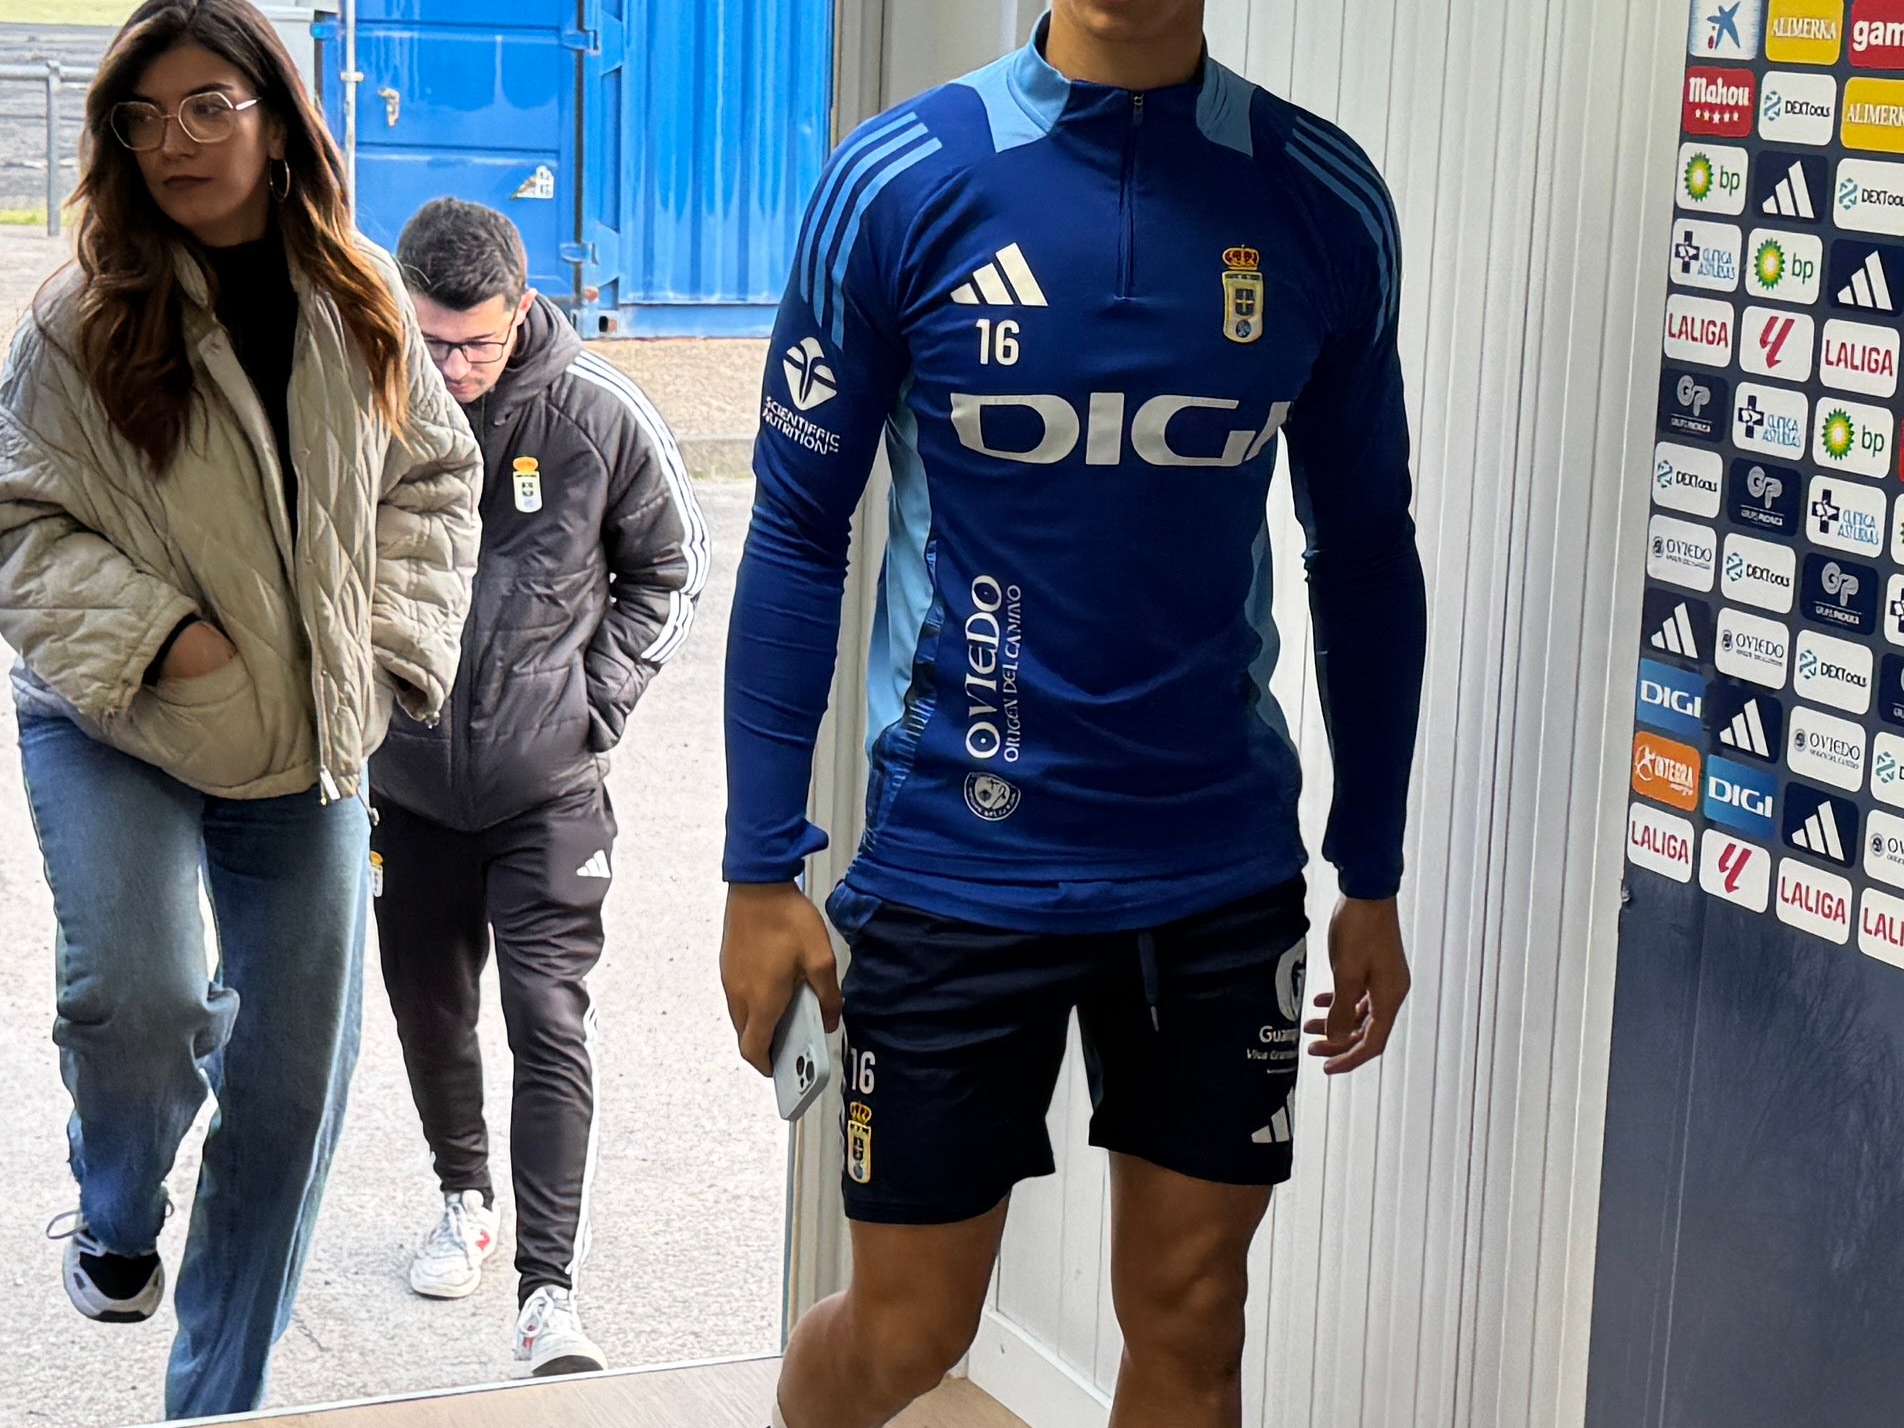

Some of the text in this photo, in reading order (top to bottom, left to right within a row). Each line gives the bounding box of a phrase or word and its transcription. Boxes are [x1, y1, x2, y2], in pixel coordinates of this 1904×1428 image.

[1689, 77, 1749, 106] Mahou
[1792, 253, 1813, 284] bp
[975, 318, 1021, 366] 16
[964, 574, 1002, 759] OVIEDO
[1641, 680, 1701, 718] DIGI
[1781, 876, 1845, 924] LALIGA
[850, 1047, 876, 1095] 16
